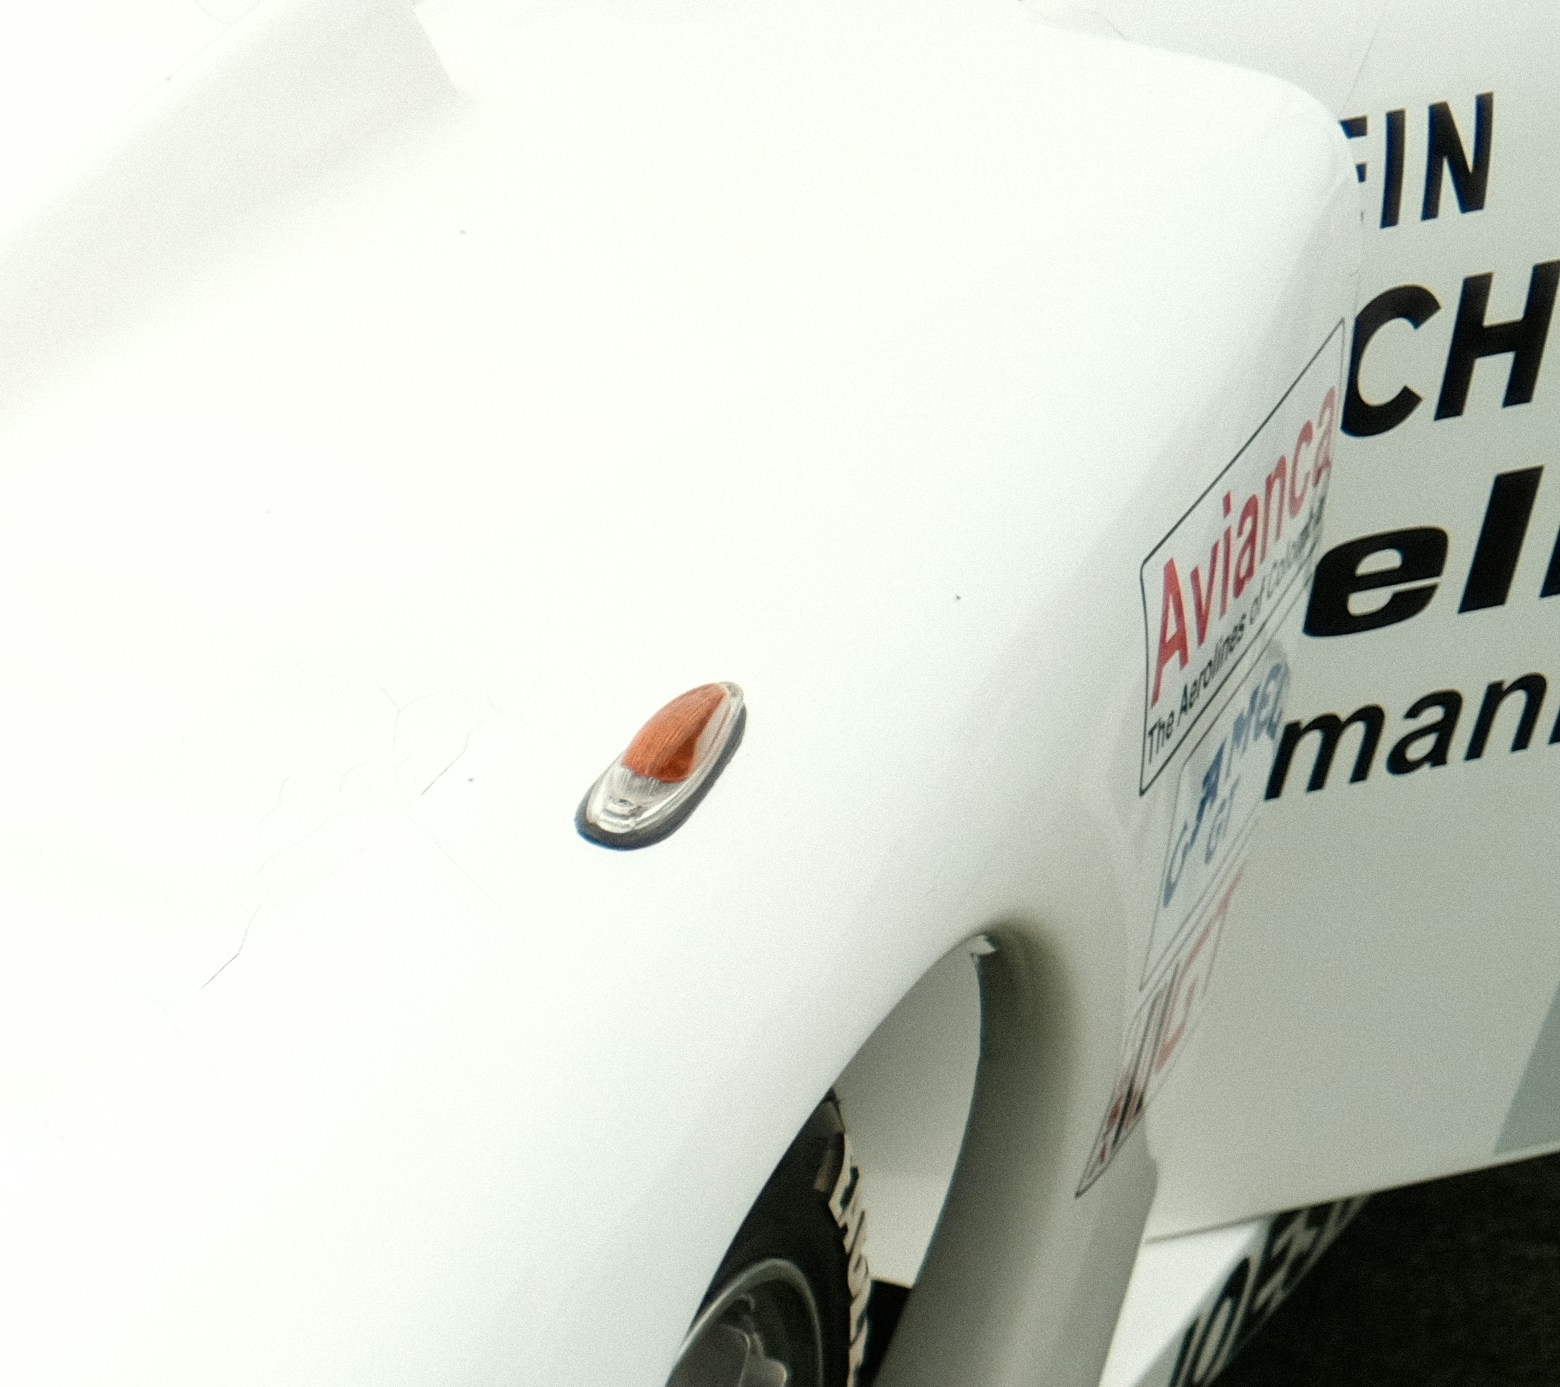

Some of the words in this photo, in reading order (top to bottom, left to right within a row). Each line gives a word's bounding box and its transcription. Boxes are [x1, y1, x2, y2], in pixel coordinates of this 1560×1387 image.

[1151, 386, 1336, 710] Avianca
[1302, 464, 1560, 637] el
[1148, 712, 1175, 764] The
[1177, 612, 1247, 717] Aerolines
[1264, 671, 1560, 801] man
